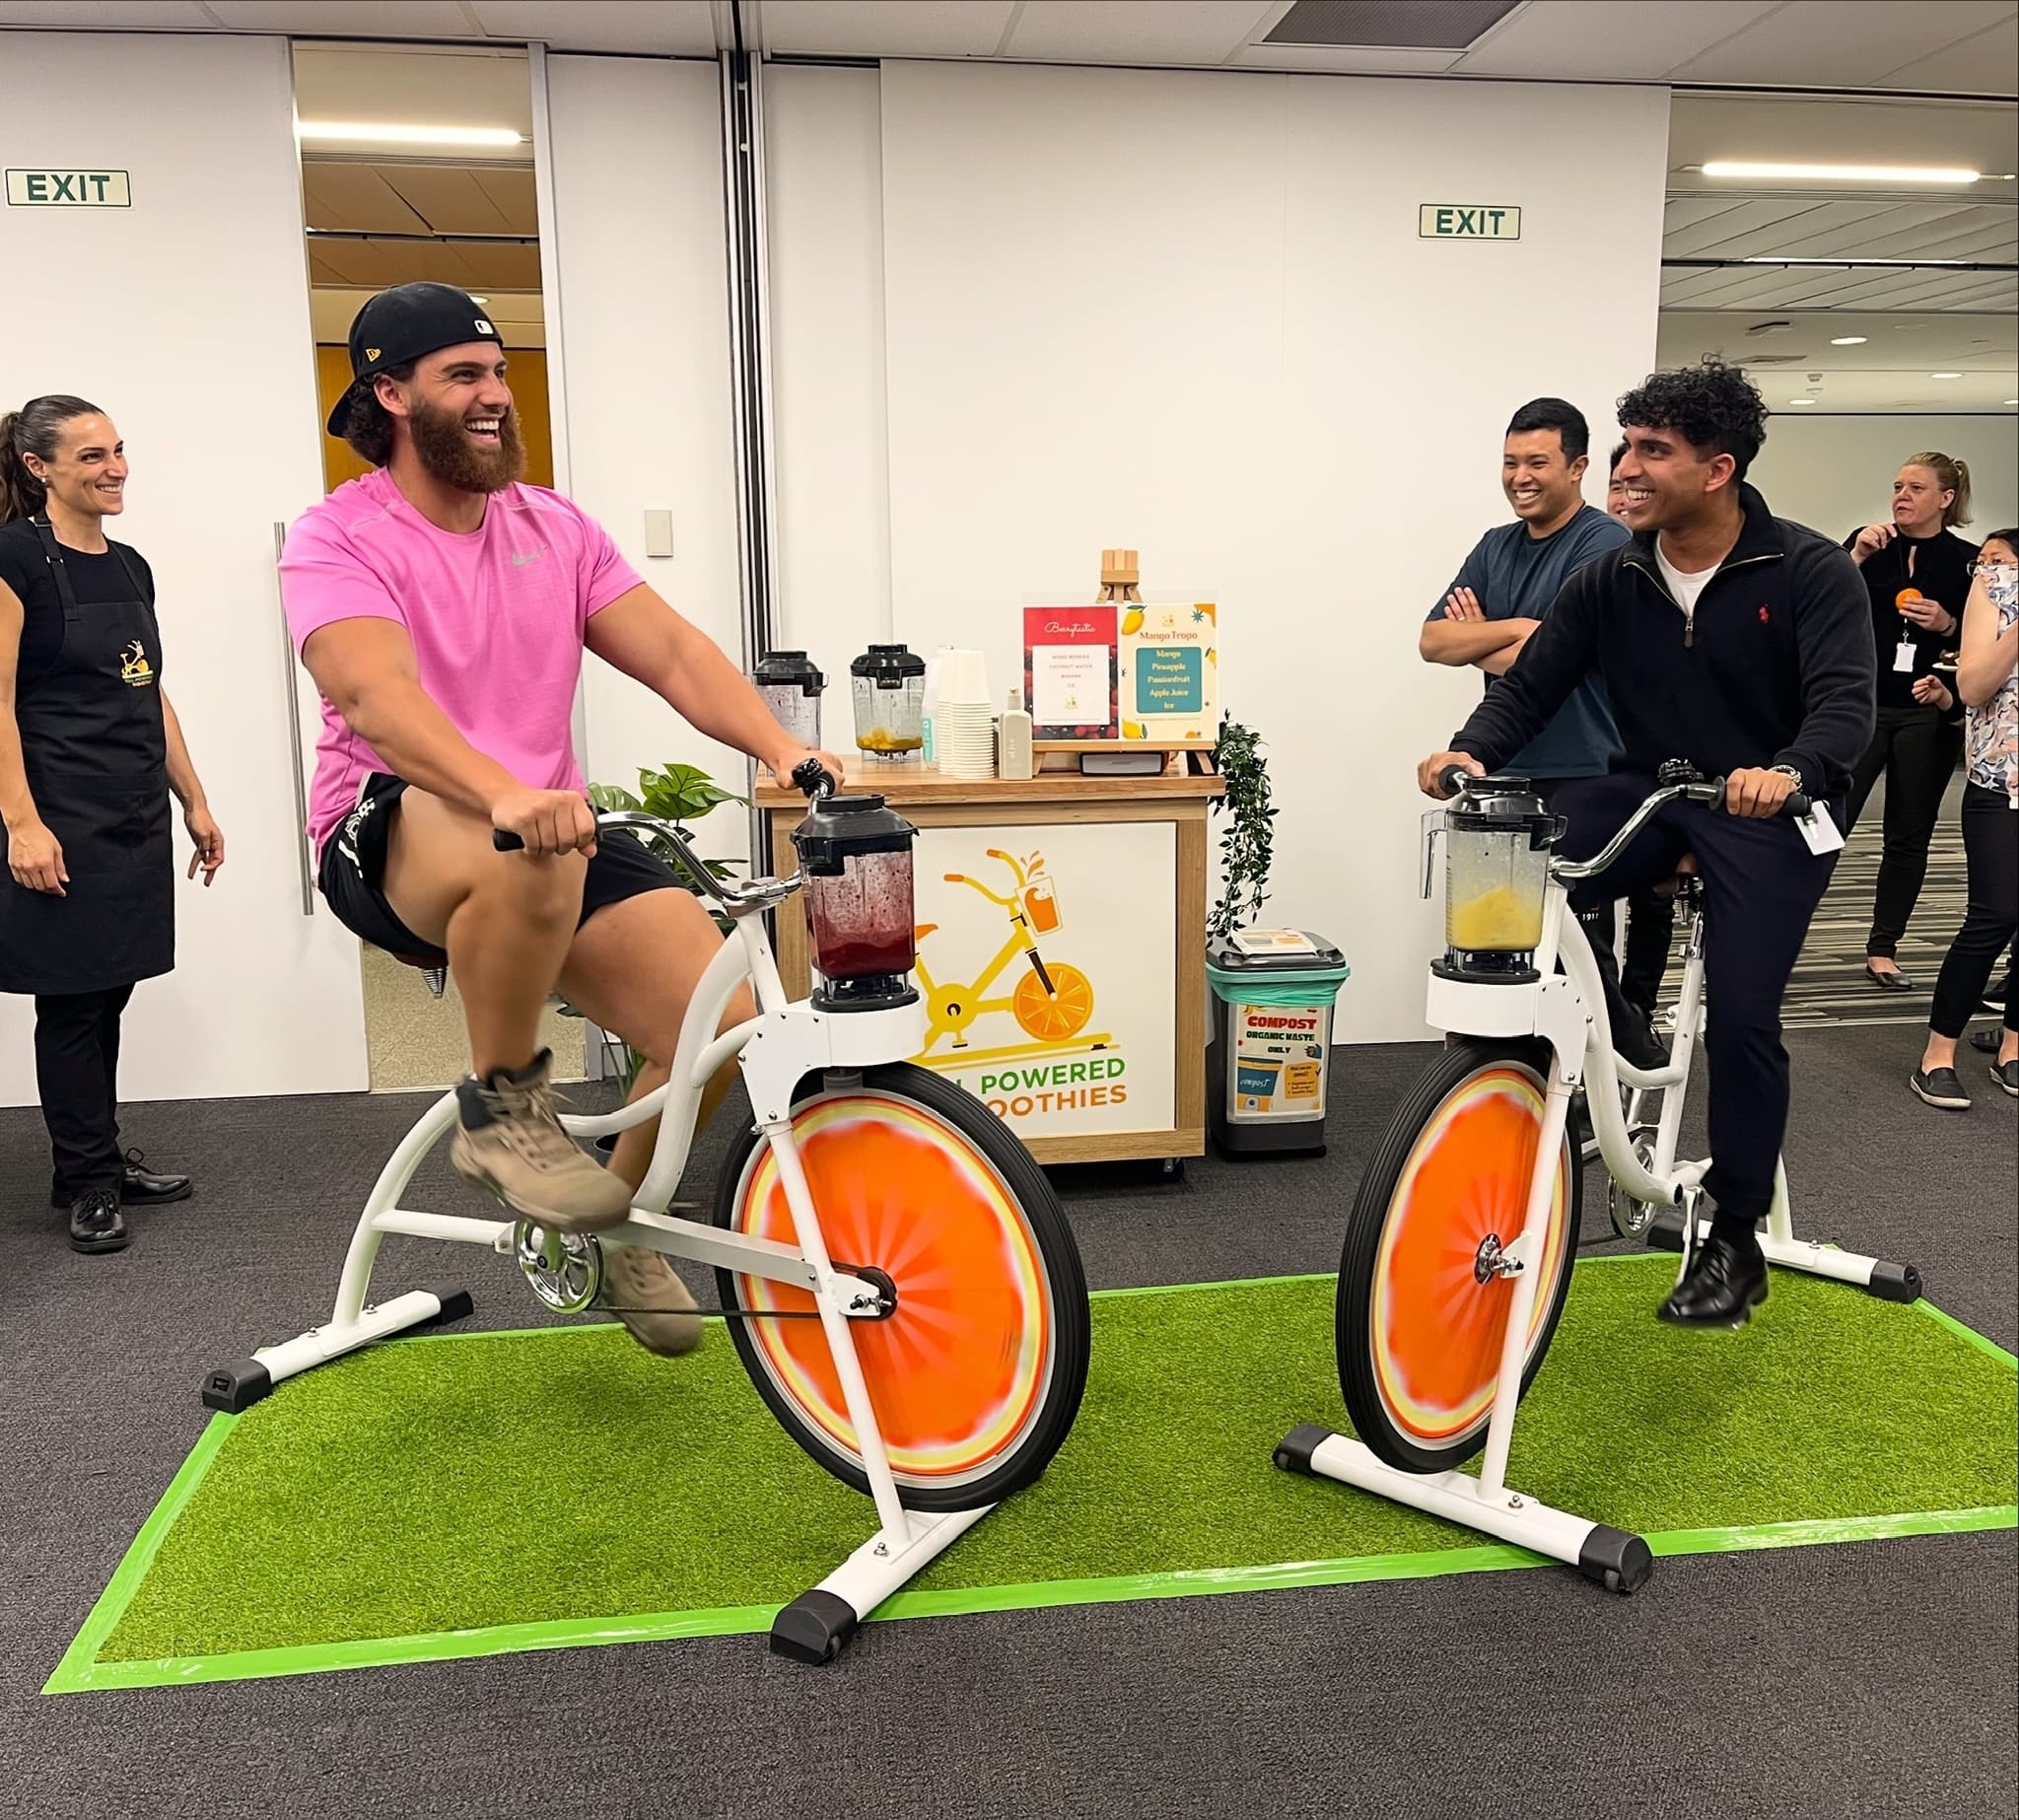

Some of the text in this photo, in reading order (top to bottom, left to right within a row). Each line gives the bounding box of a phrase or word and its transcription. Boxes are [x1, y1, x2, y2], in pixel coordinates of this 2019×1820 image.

[27, 175, 110, 201] EXIT
[1436, 210, 1505, 235] EXIT
[1140, 631, 1198, 642] Mango Tropo
[1156, 650, 1181, 659] Mango
[1151, 663, 1186, 672] Pineapple
[1248, 1016, 1317, 1029] COMPOST
[1246, 1030, 1315, 1042] ORGANIC WASTE
[981, 1058, 1126, 1094] POWERED
[986, 1085, 1128, 1118] OOTHIES
